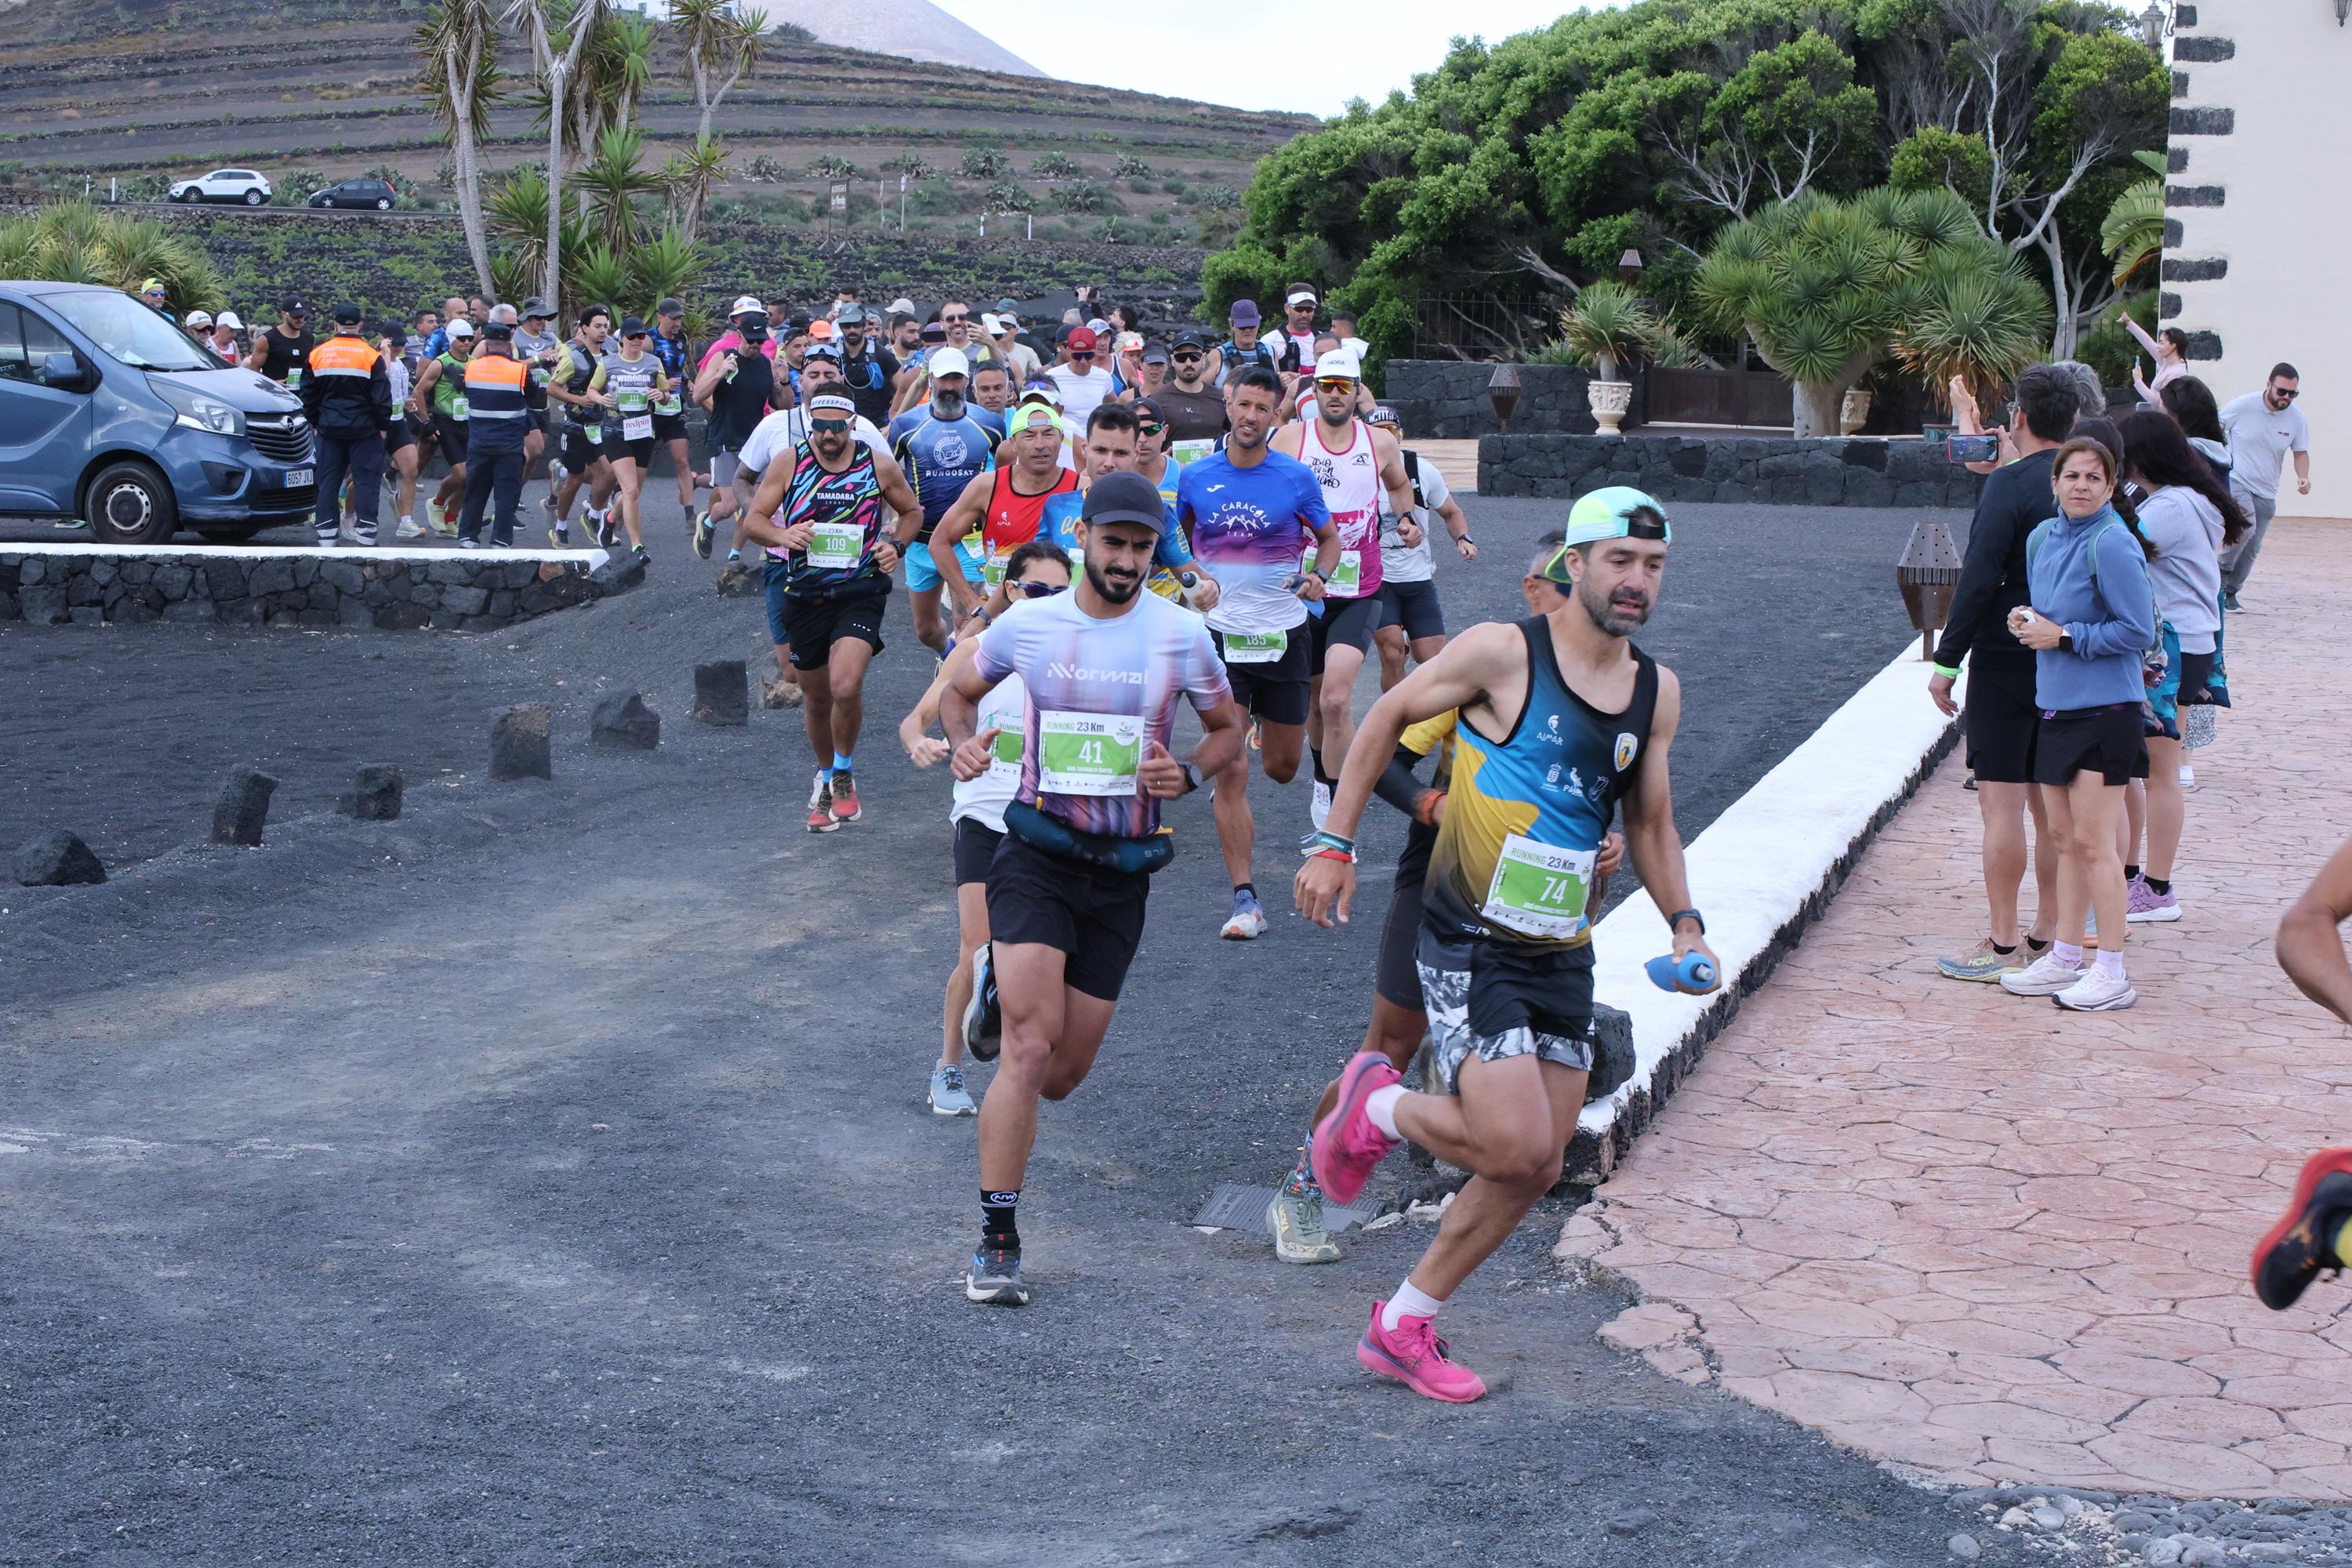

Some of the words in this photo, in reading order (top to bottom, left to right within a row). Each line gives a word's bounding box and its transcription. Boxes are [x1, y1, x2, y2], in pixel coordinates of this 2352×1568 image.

[626, 419, 649, 429] redpin
[1190, 450, 1201, 461] 96
[288, 472, 302, 485] 6057
[1208, 512, 1220, 524] LA
[826, 538, 846, 551] 109
[1245, 635, 1267, 645] 185
[999, 723, 1024, 732] RUNNING
[1047, 720, 1075, 731] RUNNING
[1077, 721, 1089, 731] 23
[1091, 722, 1105, 732] Km
[1079, 740, 1103, 764] 41
[1511, 848, 1547, 865] RUNNING
[1547, 856, 1561, 869] 23
[1561, 858, 1576, 871] Km
[1539, 876, 1568, 904] 74
[1967, 956, 1995, 967] HOKA
